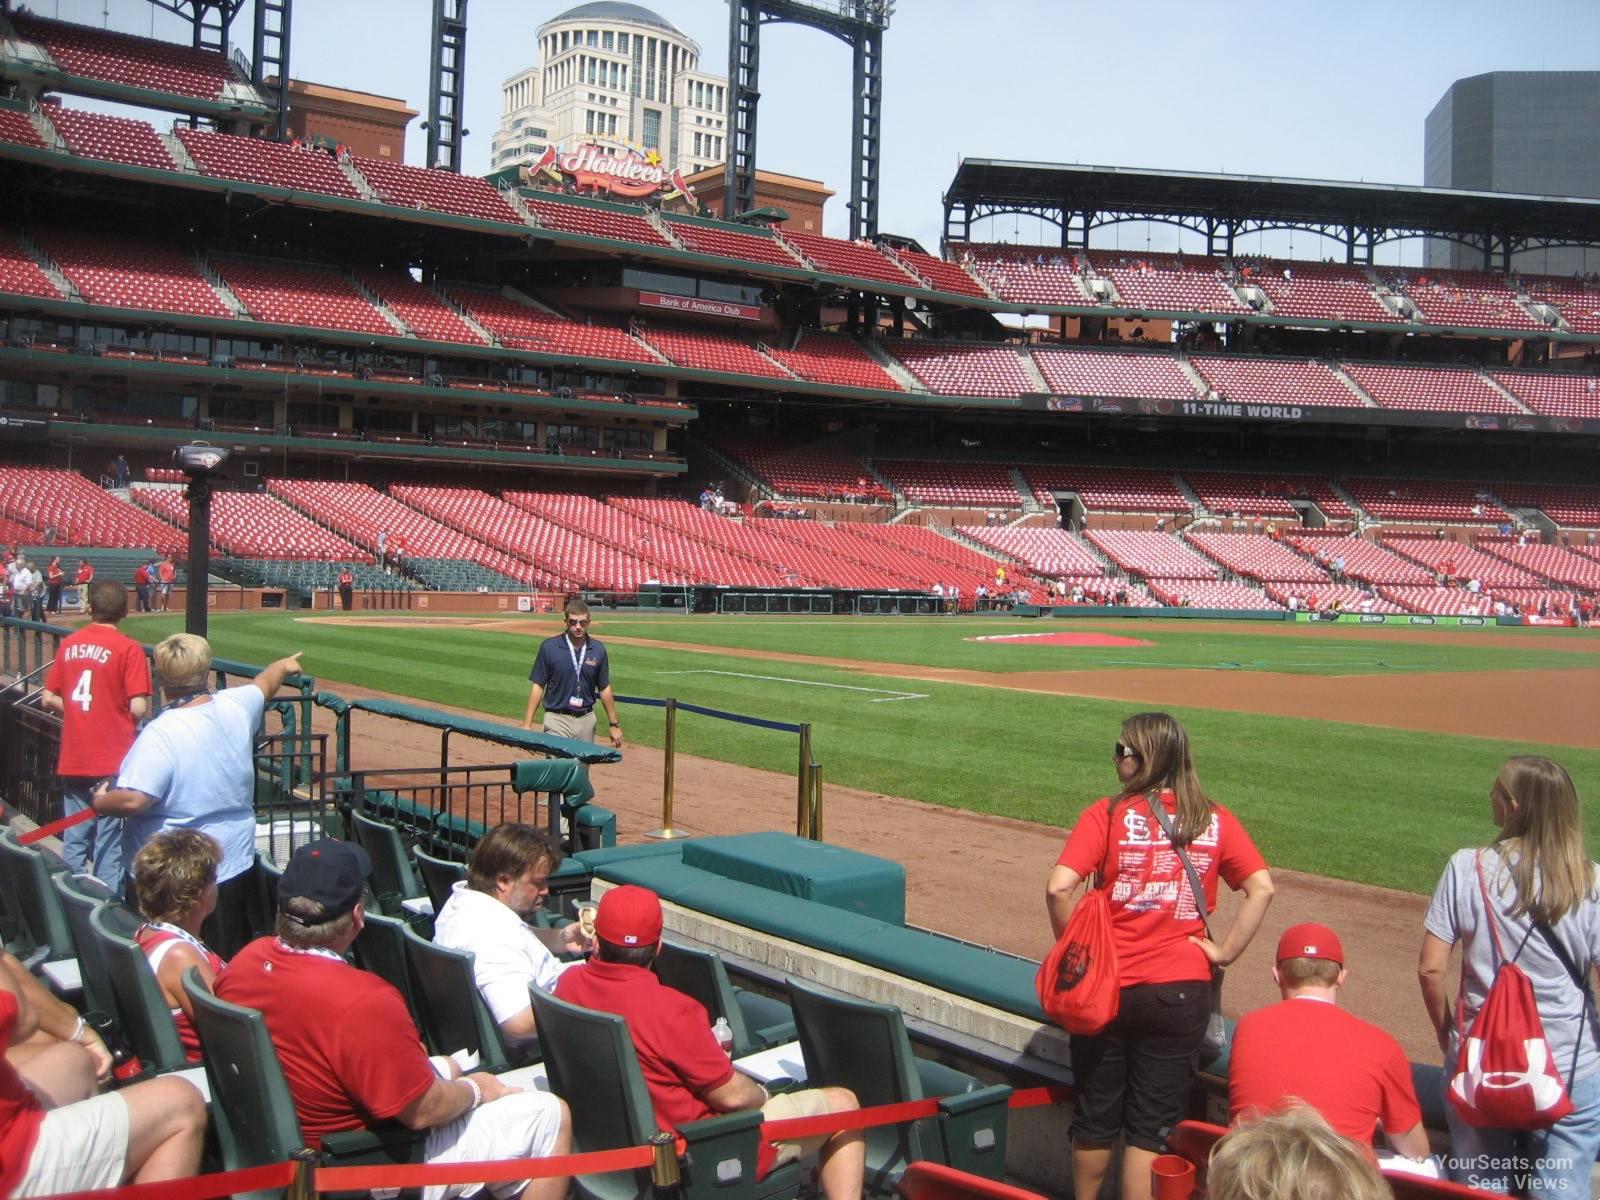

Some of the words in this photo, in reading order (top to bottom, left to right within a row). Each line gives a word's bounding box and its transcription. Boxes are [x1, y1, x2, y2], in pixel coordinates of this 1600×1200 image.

[660, 296, 680, 307] Bank
[682, 299, 690, 309] of
[691, 301, 722, 313] America
[724, 305, 740, 316] Club
[1182, 402, 1242, 416] 11-TIME
[1247, 405, 1302, 419] WORLD
[64, 643, 112, 664] RASMUS
[71, 669, 93, 712] 4
[1112, 881, 1131, 895] 2013
